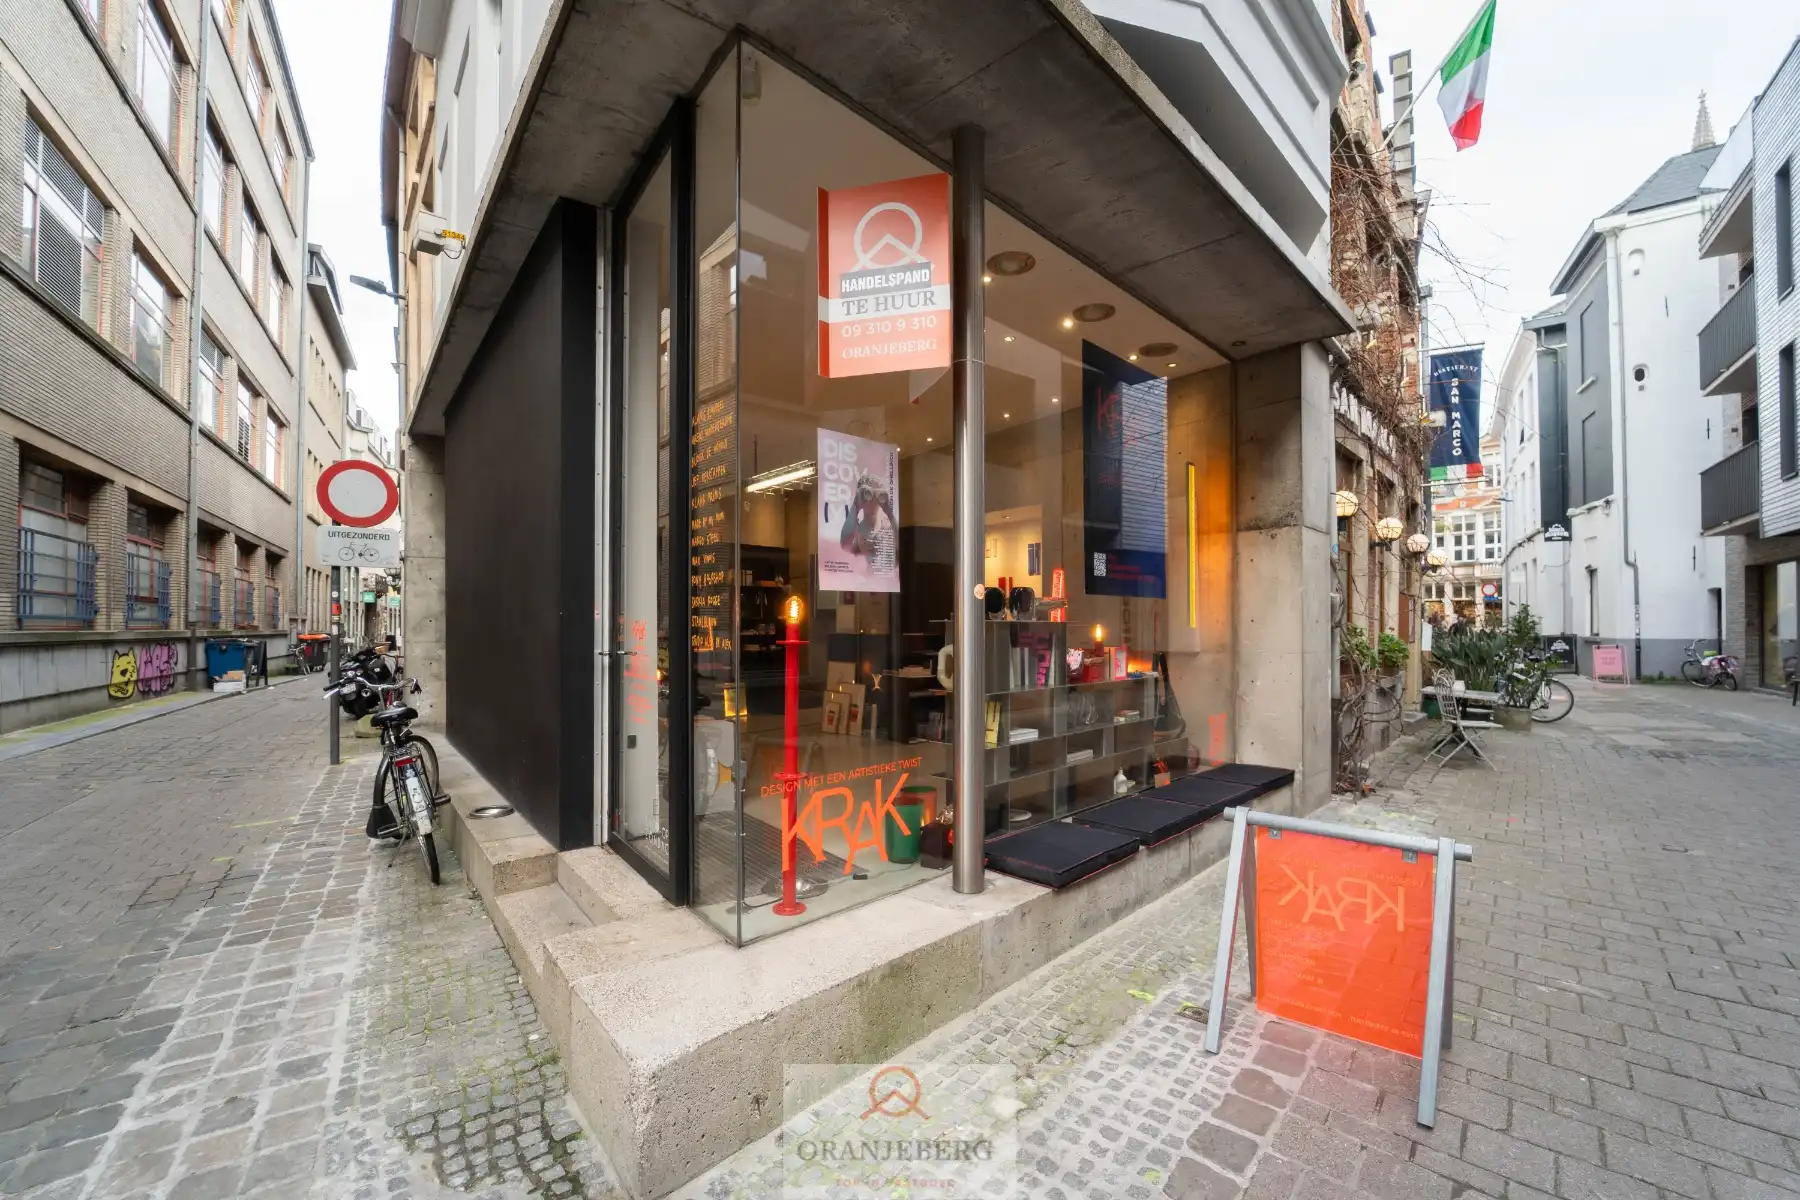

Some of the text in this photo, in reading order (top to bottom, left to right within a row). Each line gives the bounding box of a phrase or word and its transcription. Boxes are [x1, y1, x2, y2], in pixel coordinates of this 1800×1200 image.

[841, 269, 931, 293] HANDELSPAND
[842, 290, 937, 316] TE HUUR
[841, 314, 937, 338] 09 310 9 310
[842, 338, 938, 359] ORANJEBERG
[1450, 377, 1462, 456] SAN MARCO
[823, 438, 857, 462] DIS
[327, 530, 391, 541] UITGEZONDERD
[760, 757, 923, 797] DESIGN MET EEN ARTISTIEKE TWIST
[781, 772, 912, 876] KRAK
